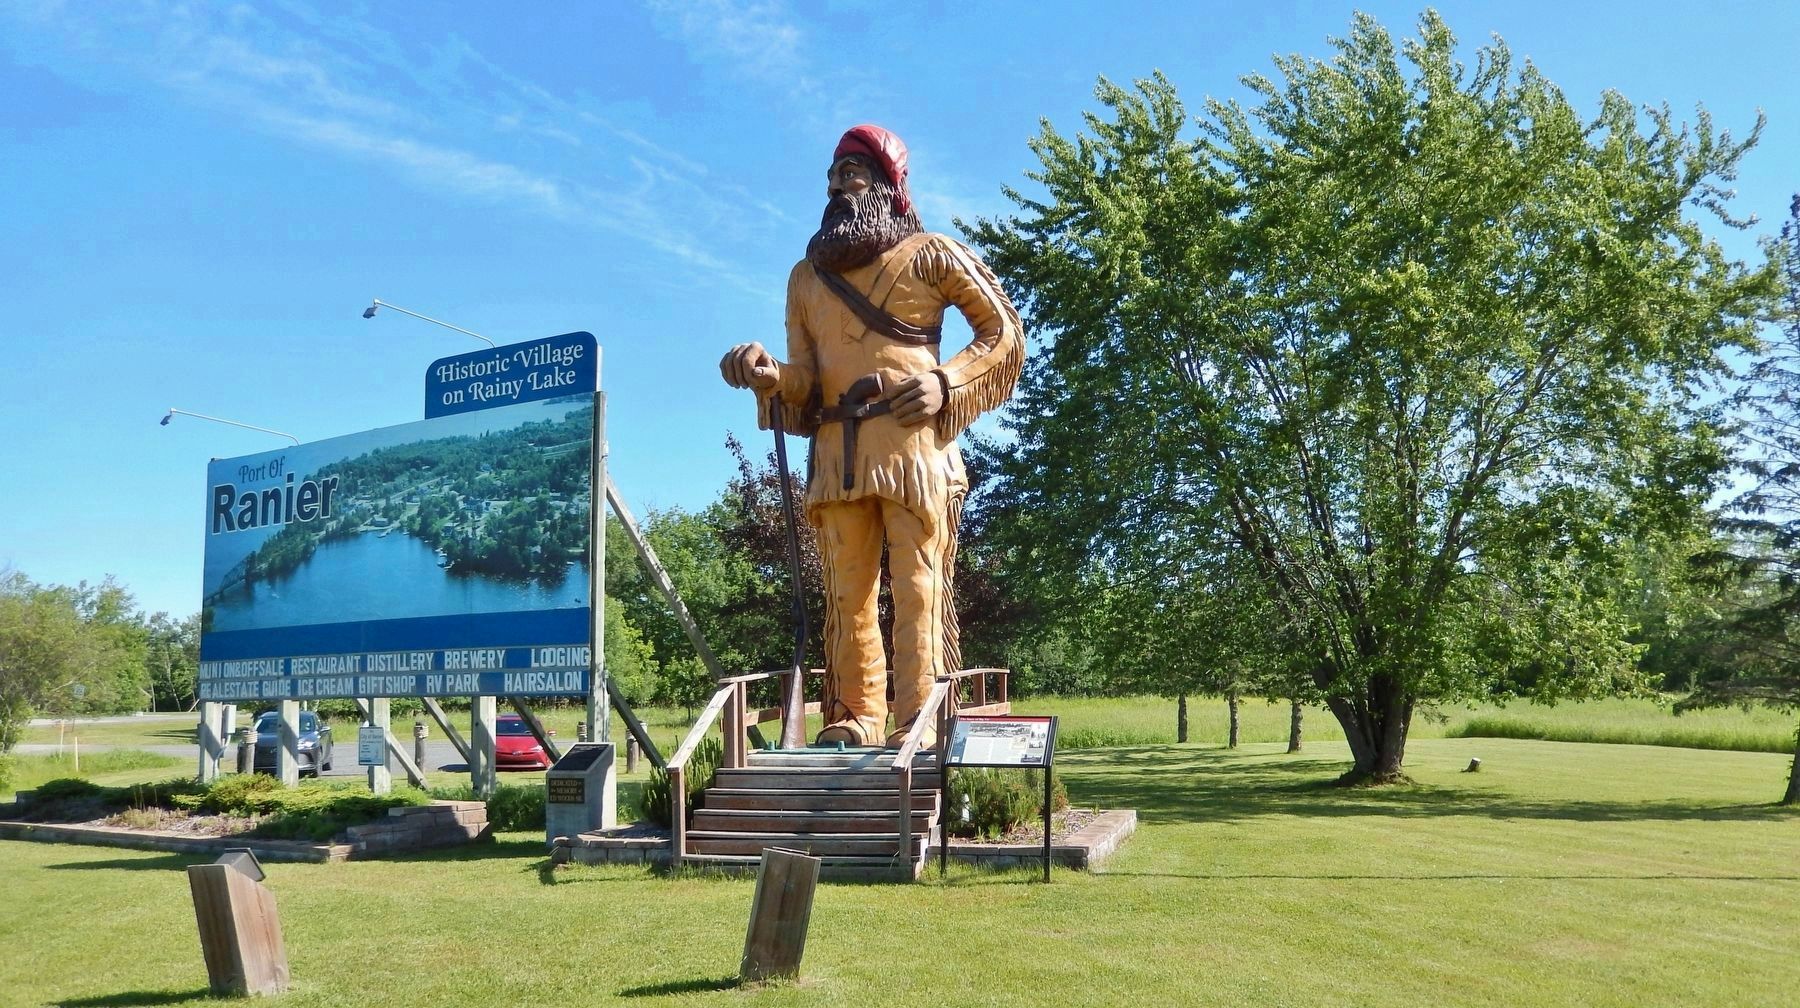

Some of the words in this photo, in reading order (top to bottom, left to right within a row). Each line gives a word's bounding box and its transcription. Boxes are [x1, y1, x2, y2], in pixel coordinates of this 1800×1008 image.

[436, 354, 510, 383] Historic
[513, 343, 584, 368] Village
[443, 389, 464, 405] on
[468, 378, 523, 402] Rainy
[527, 366, 576, 391] Lake
[239, 463, 266, 483] Port
[269, 455, 286, 478] Of
[212, 472, 340, 535] Ranier
[291, 655, 361, 675] RESTAURANT
[367, 652, 434, 672] DISTILLERY
[444, 649, 505, 669] BREWERY
[530, 647, 590, 667] LODGING
[262, 679, 291, 697] GUIDE
[315, 677, 354, 695] CREAM
[426, 674, 442, 693] RV
[446, 673, 480, 693] PARK
[504, 671, 582, 693] HAIRSALON
